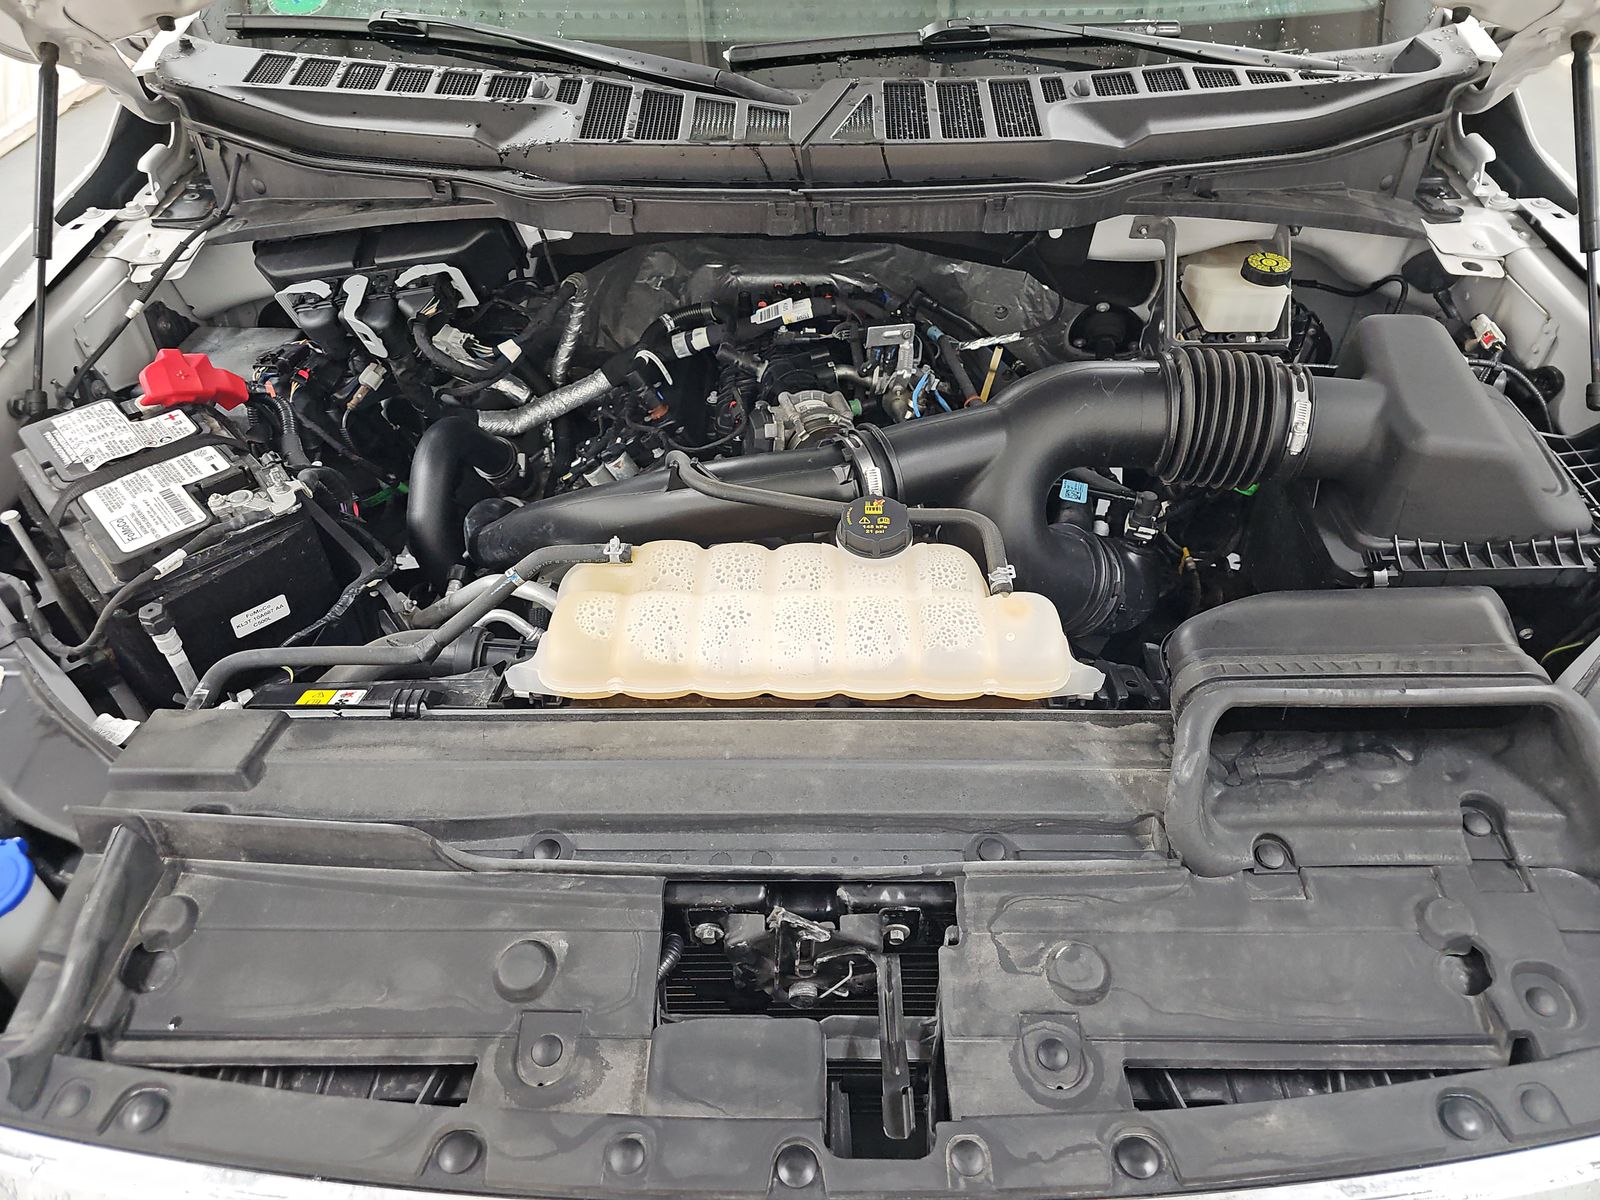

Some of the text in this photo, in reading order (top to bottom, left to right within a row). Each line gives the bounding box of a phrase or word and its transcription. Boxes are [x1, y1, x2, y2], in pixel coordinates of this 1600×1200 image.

[116, 518, 137, 541] FoMoCo
[245, 604, 271, 618] FoMoCo
[236, 619, 251, 629] KL3T
